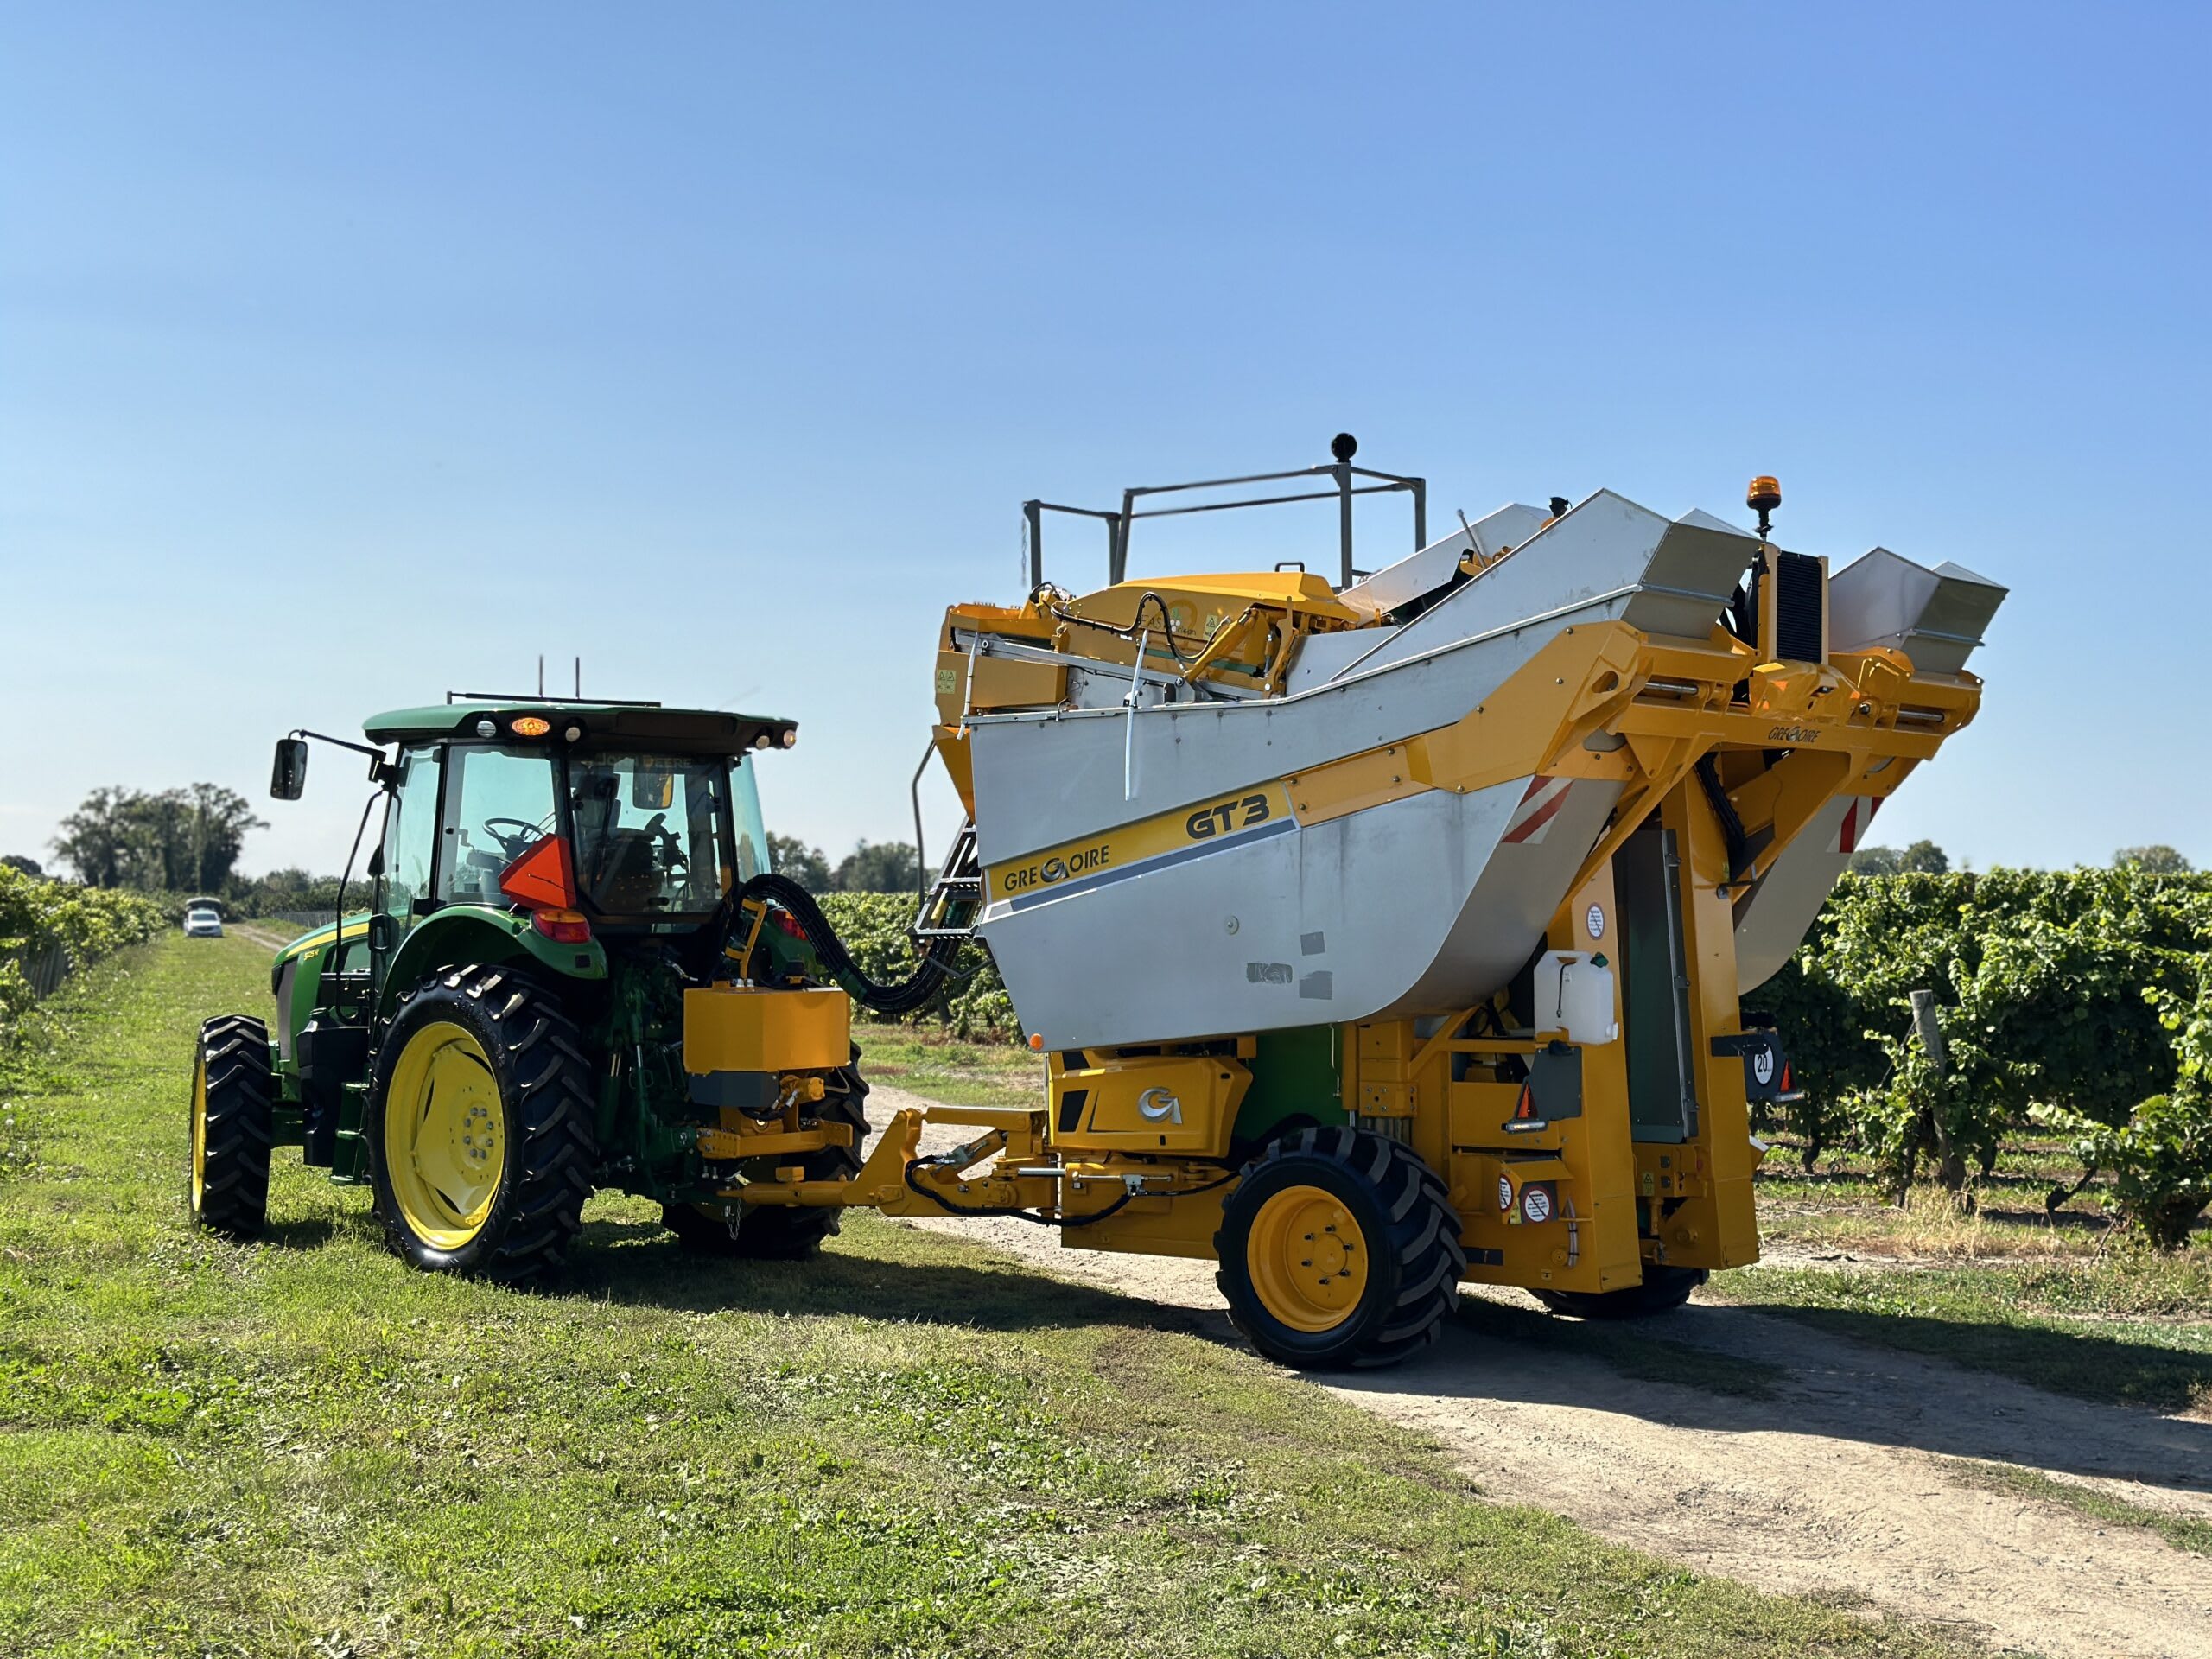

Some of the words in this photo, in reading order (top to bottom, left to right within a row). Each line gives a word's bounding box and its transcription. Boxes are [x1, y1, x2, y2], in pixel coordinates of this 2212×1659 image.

[1768, 726, 1821, 743] GREGOIRE
[1186, 794, 1270, 840] GT3
[1004, 845, 1109, 892] GREGOIRE
[1758, 1054, 1768, 1073] 20
